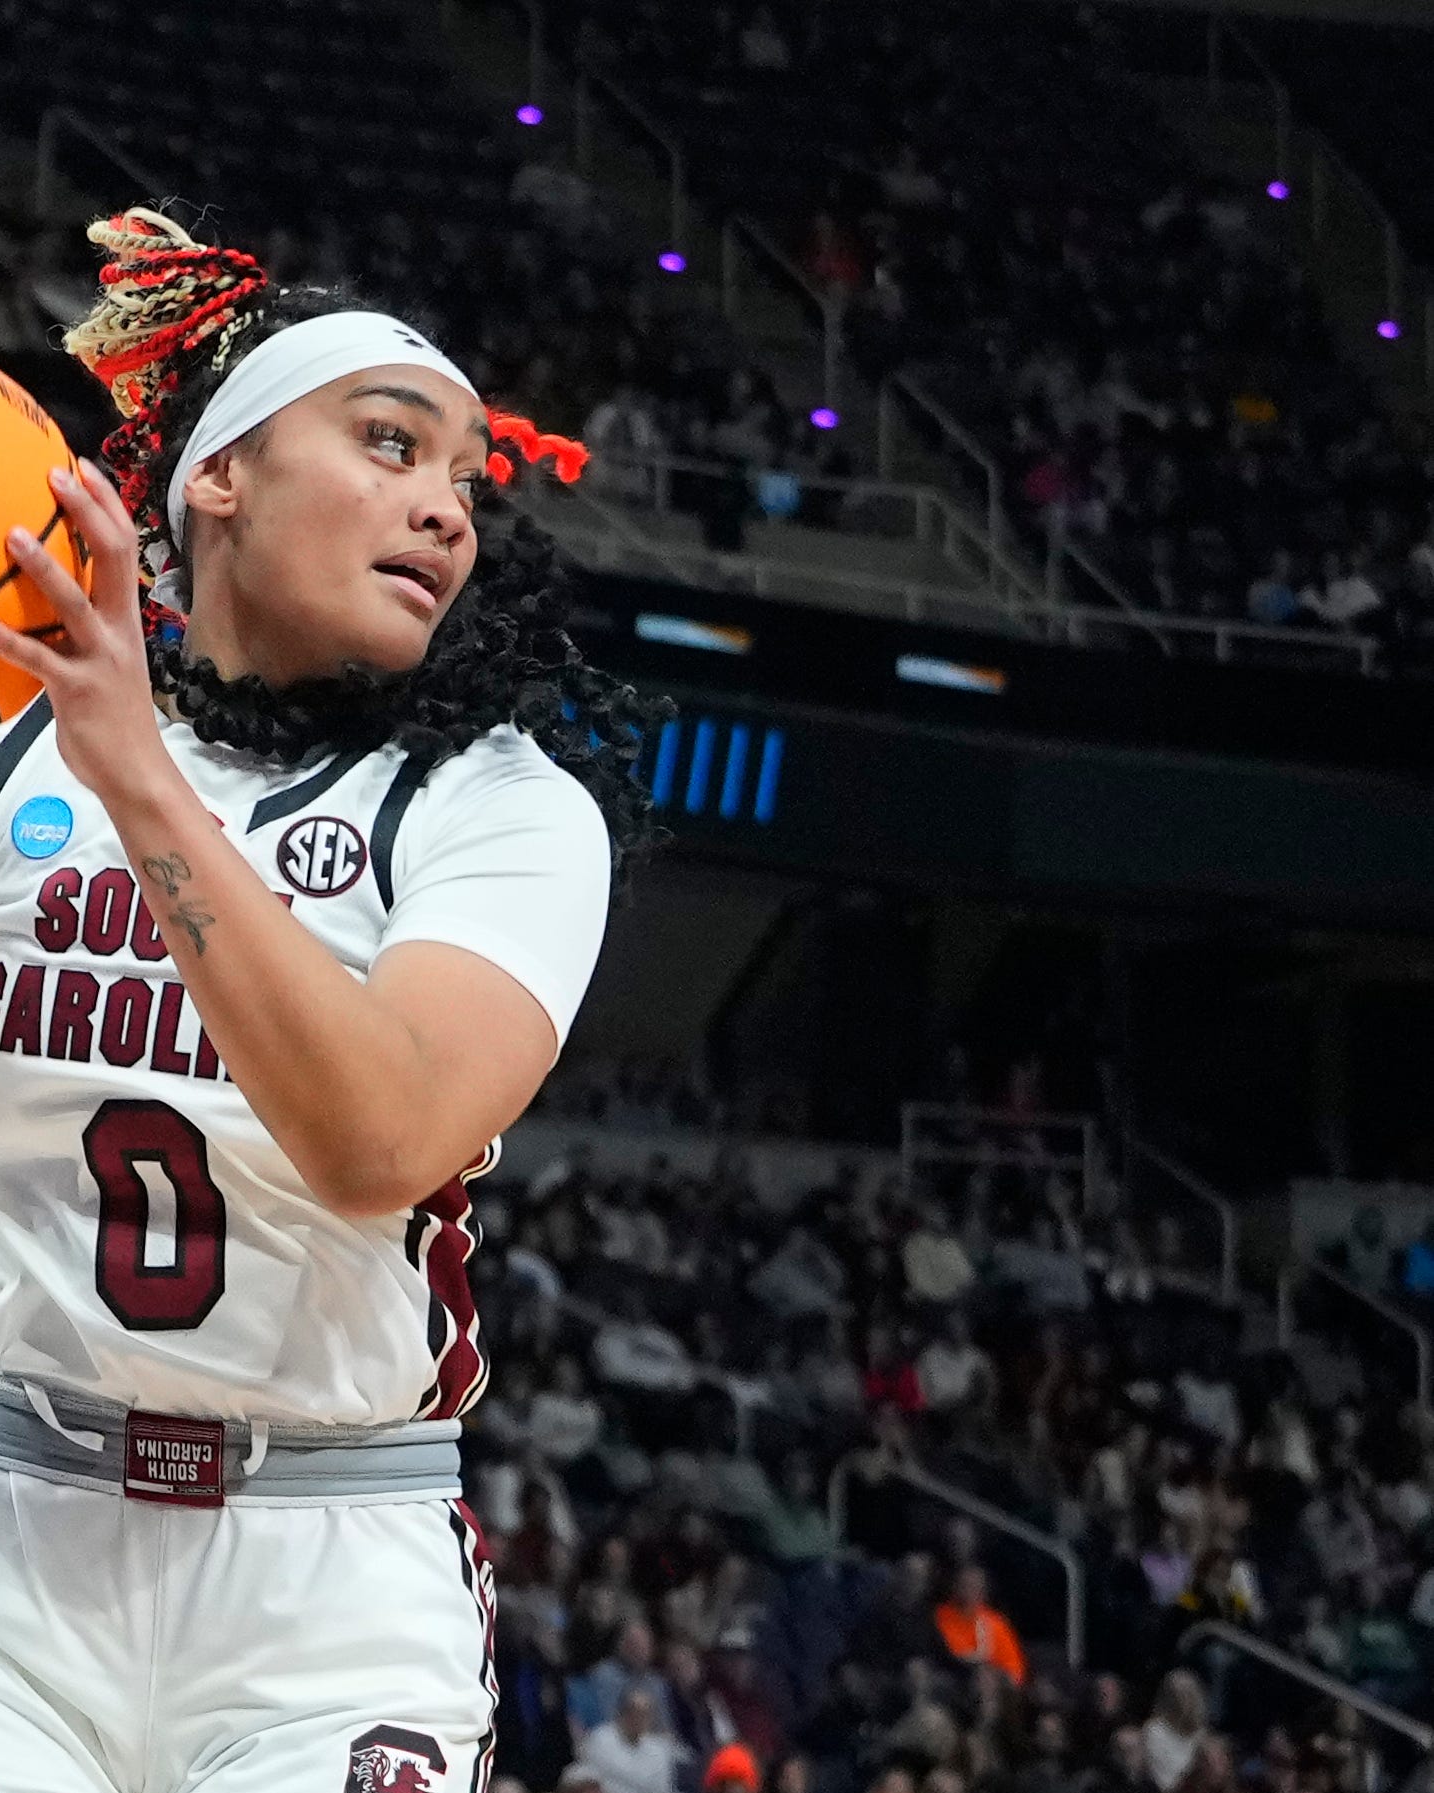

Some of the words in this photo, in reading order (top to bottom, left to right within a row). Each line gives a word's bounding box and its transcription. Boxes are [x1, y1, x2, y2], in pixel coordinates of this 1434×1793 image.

[18, 822, 69, 842] NCAA
[284, 820, 360, 891] SEC
[83, 1099, 226, 1331] 0
[135, 1438, 213, 1463] CAROLINA
[147, 1460, 198, 1482] SOUTH
